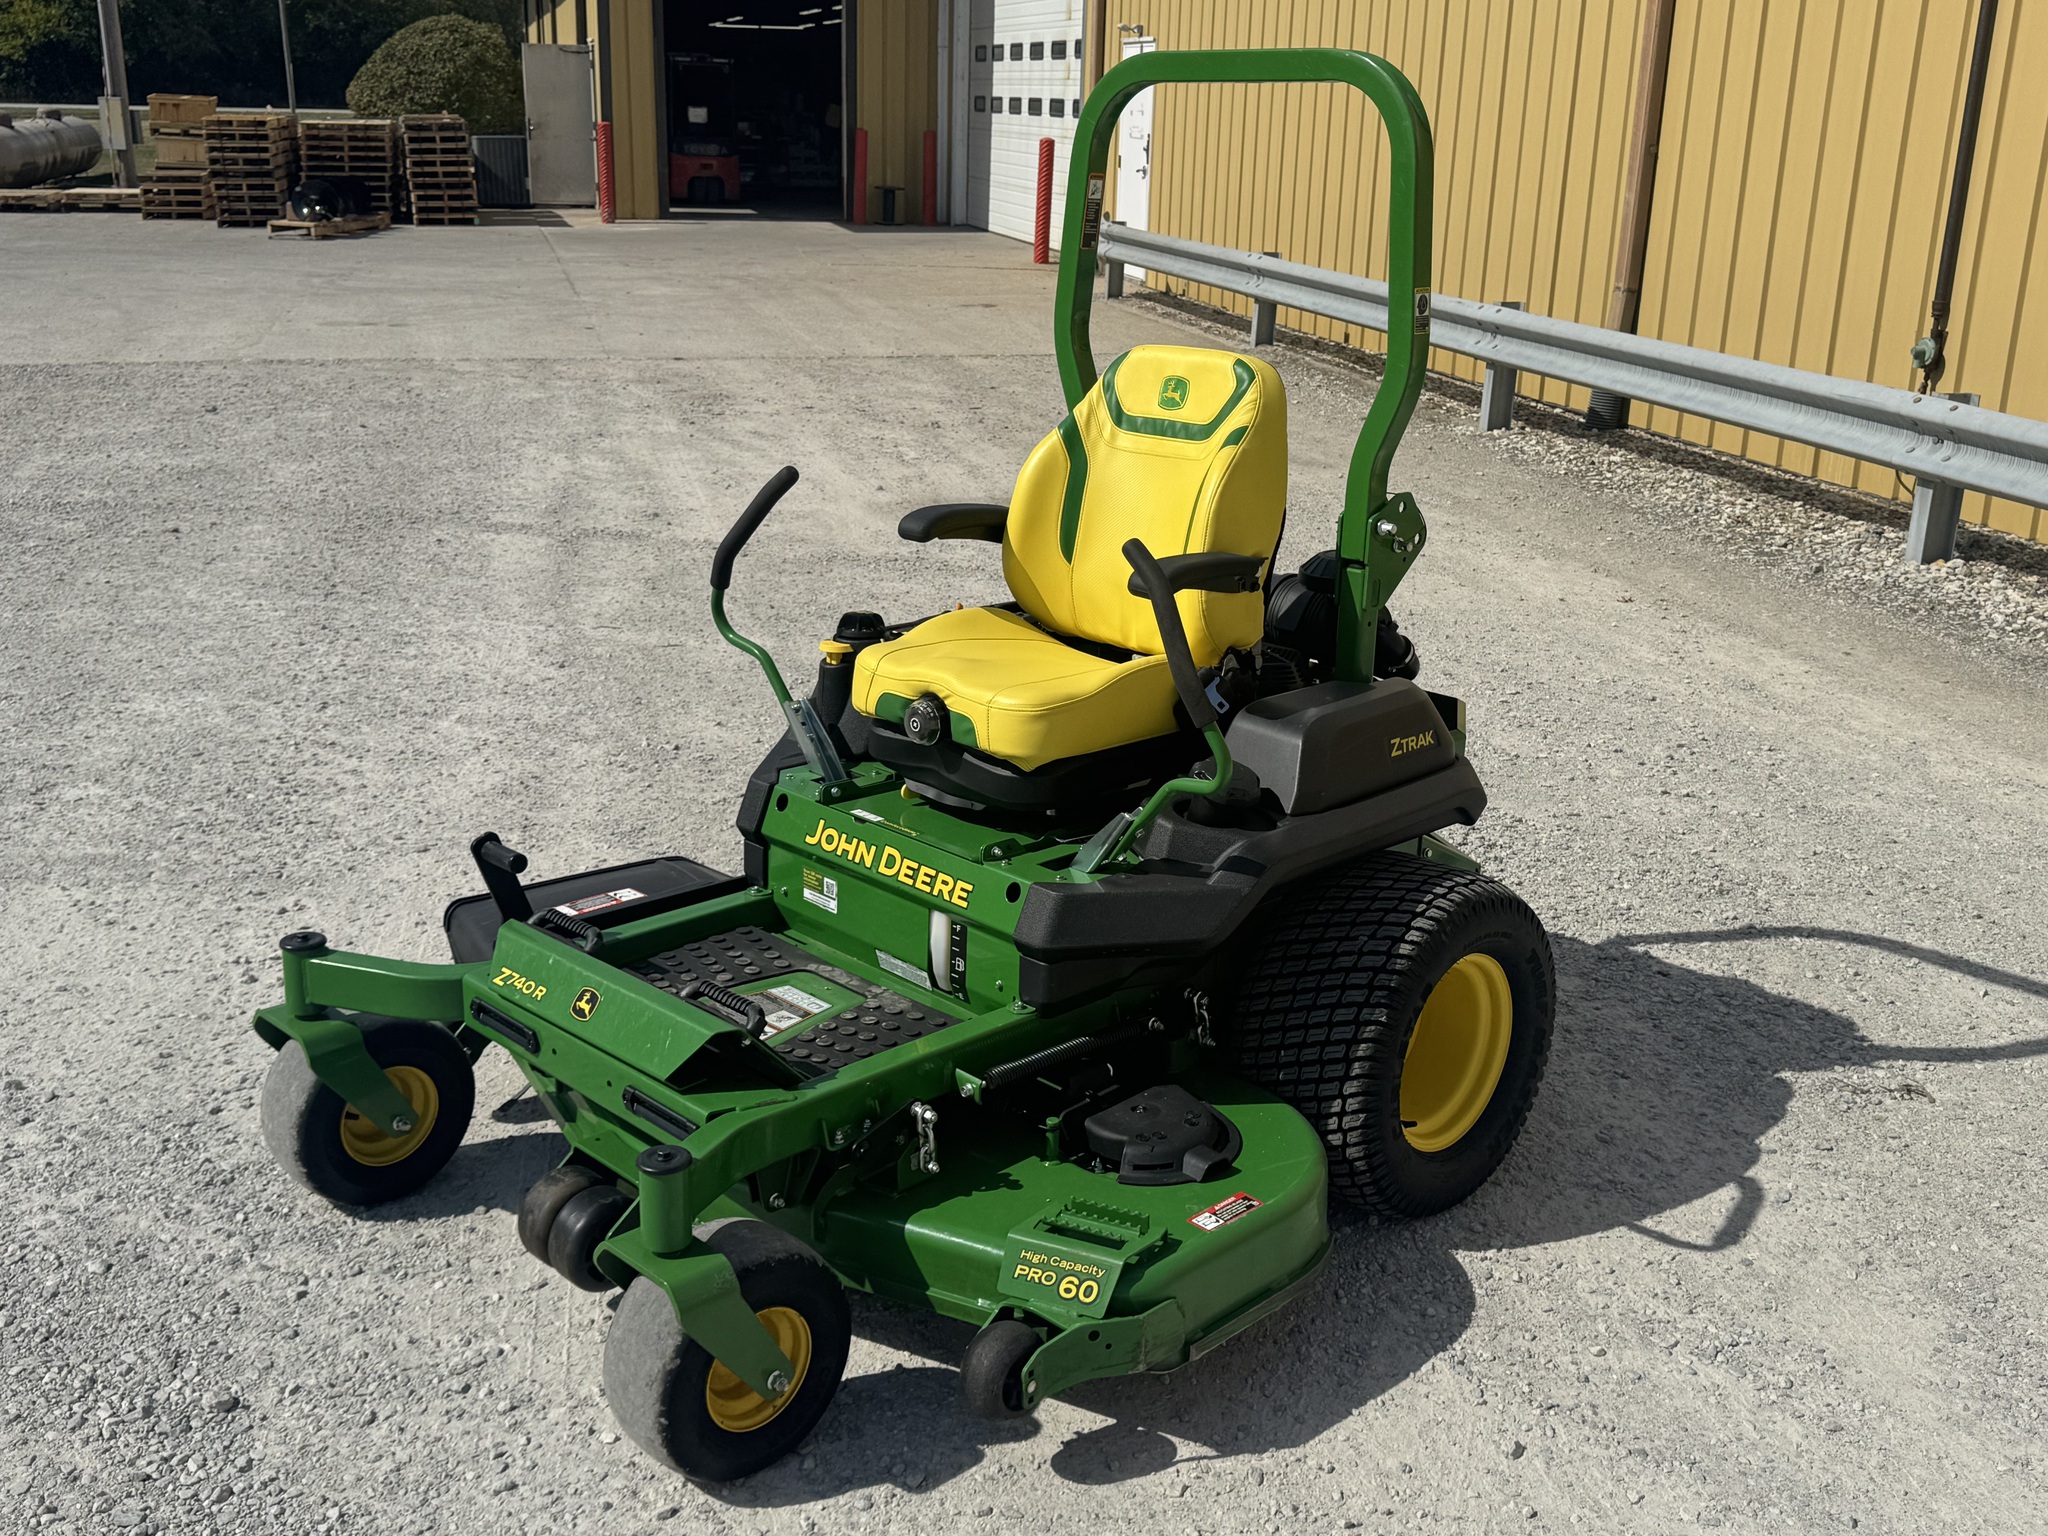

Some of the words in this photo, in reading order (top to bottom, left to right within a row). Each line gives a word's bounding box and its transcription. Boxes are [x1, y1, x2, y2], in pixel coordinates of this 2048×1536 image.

[684, 143, 728, 155] TOYOTA
[1390, 730, 1435, 757] ZTRAK
[805, 819, 877, 868] JOHN
[877, 845, 974, 909] DEERE
[492, 966, 547, 1001] Z740R
[1019, 1249, 1048, 1264] High
[1050, 1256, 1106, 1279] Capacity
[1013, 1264, 1057, 1286] PRO
[1058, 1275, 1099, 1304] 60
